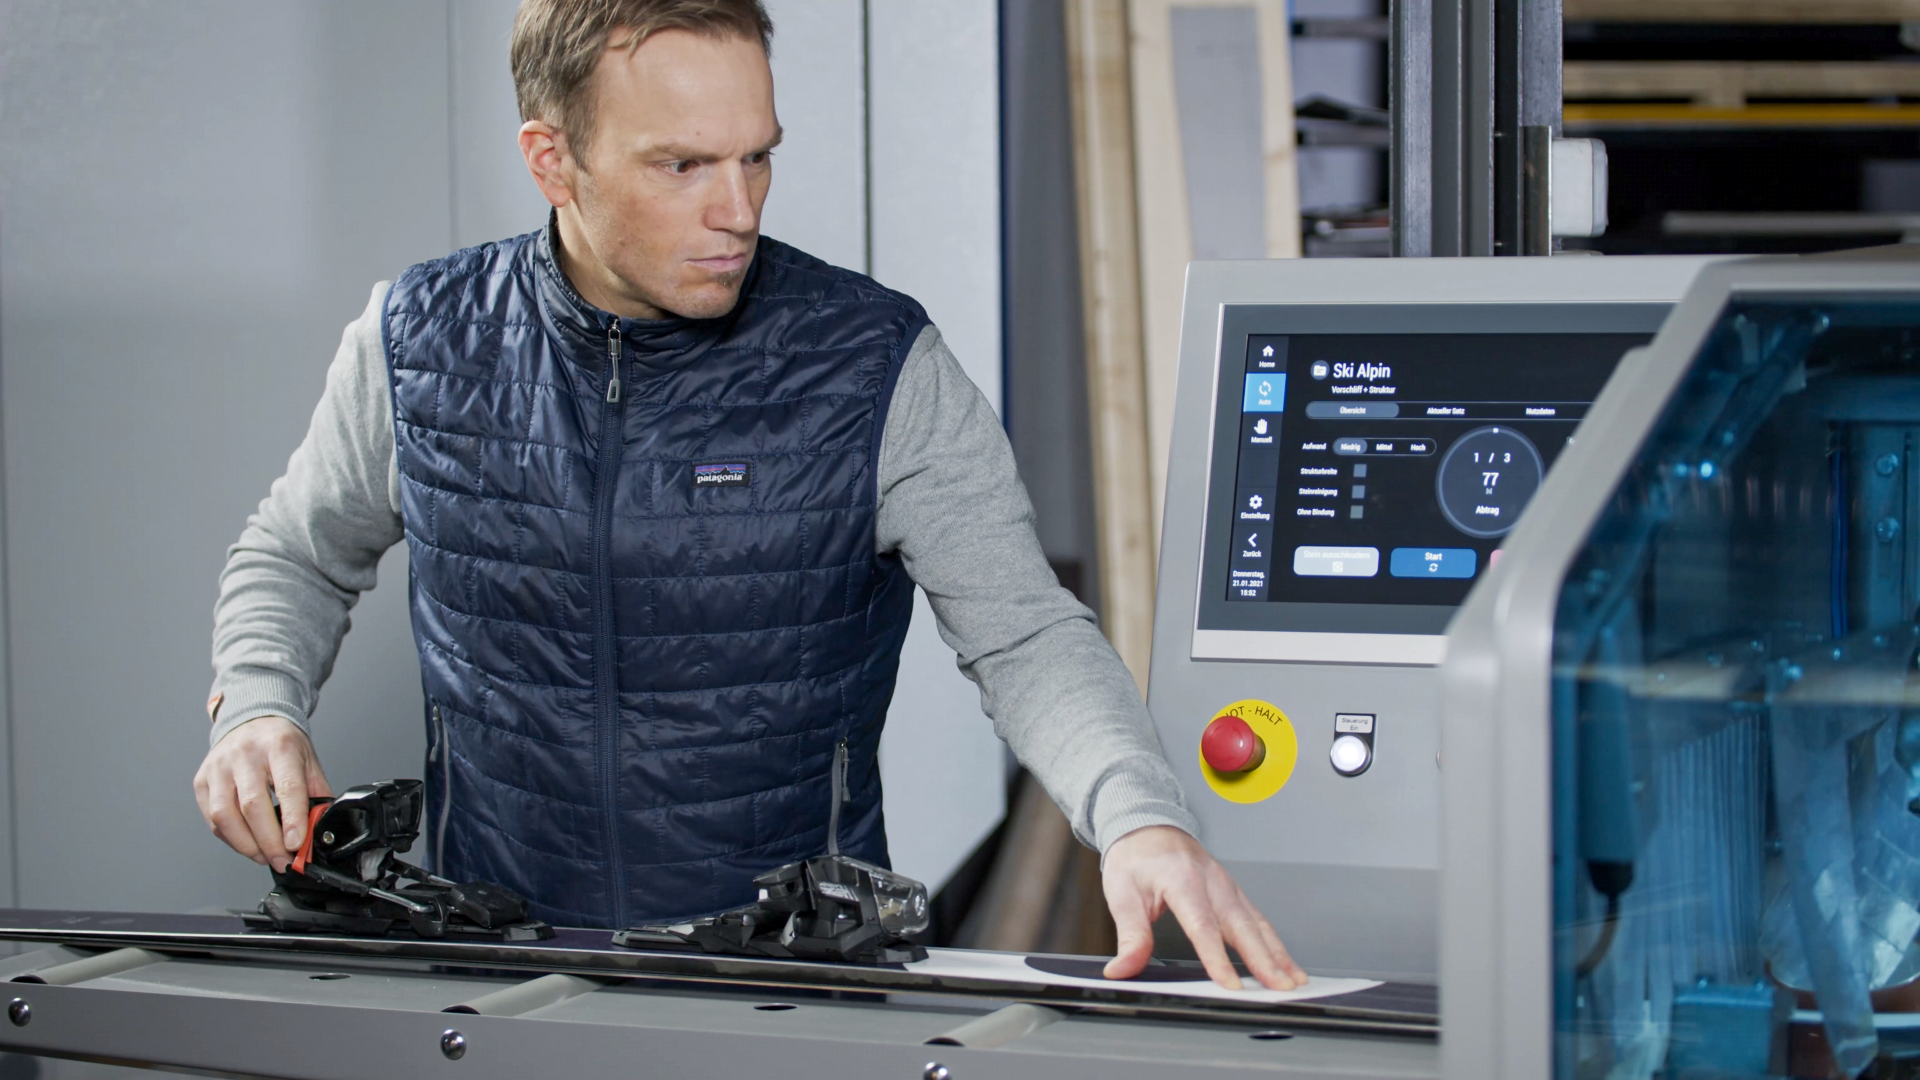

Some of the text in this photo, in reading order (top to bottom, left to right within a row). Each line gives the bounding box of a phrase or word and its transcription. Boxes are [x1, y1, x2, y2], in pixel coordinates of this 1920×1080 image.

[1333, 363, 1391, 381] Ski Alpin
[1331, 385, 1363, 394] Vorschliff
[1369, 386, 1396, 394] Struktur
[1340, 406, 1366, 414] Übersicht
[1427, 407, 1451, 415] Aktueller
[1526, 407, 1555, 415] Nutzdaten
[1302, 442, 1326, 450] Aufwand
[1340, 443, 1361, 452] Niedrig
[1376, 443, 1393, 451] Mittel
[1503, 453, 1511, 463] 3
[1300, 467, 1338, 475] Strukturbreite
[697, 473, 743, 484] patagonia
[1482, 472, 1499, 486] 77
[1299, 488, 1338, 497] Steinreinigung
[1297, 508, 1335, 517] Ohne Bindung
[1475, 505, 1500, 516] Abtrag
[1303, 550, 1370, 559] Stein ausschleudern
[1425, 552, 1442, 561] Start
[1232, 579, 1263, 588] 21.01.2021
[1225, 705, 1245, 717] OT
[1254, 705, 1283, 726] HALT
[1341, 717, 1368, 725] Steuerung
